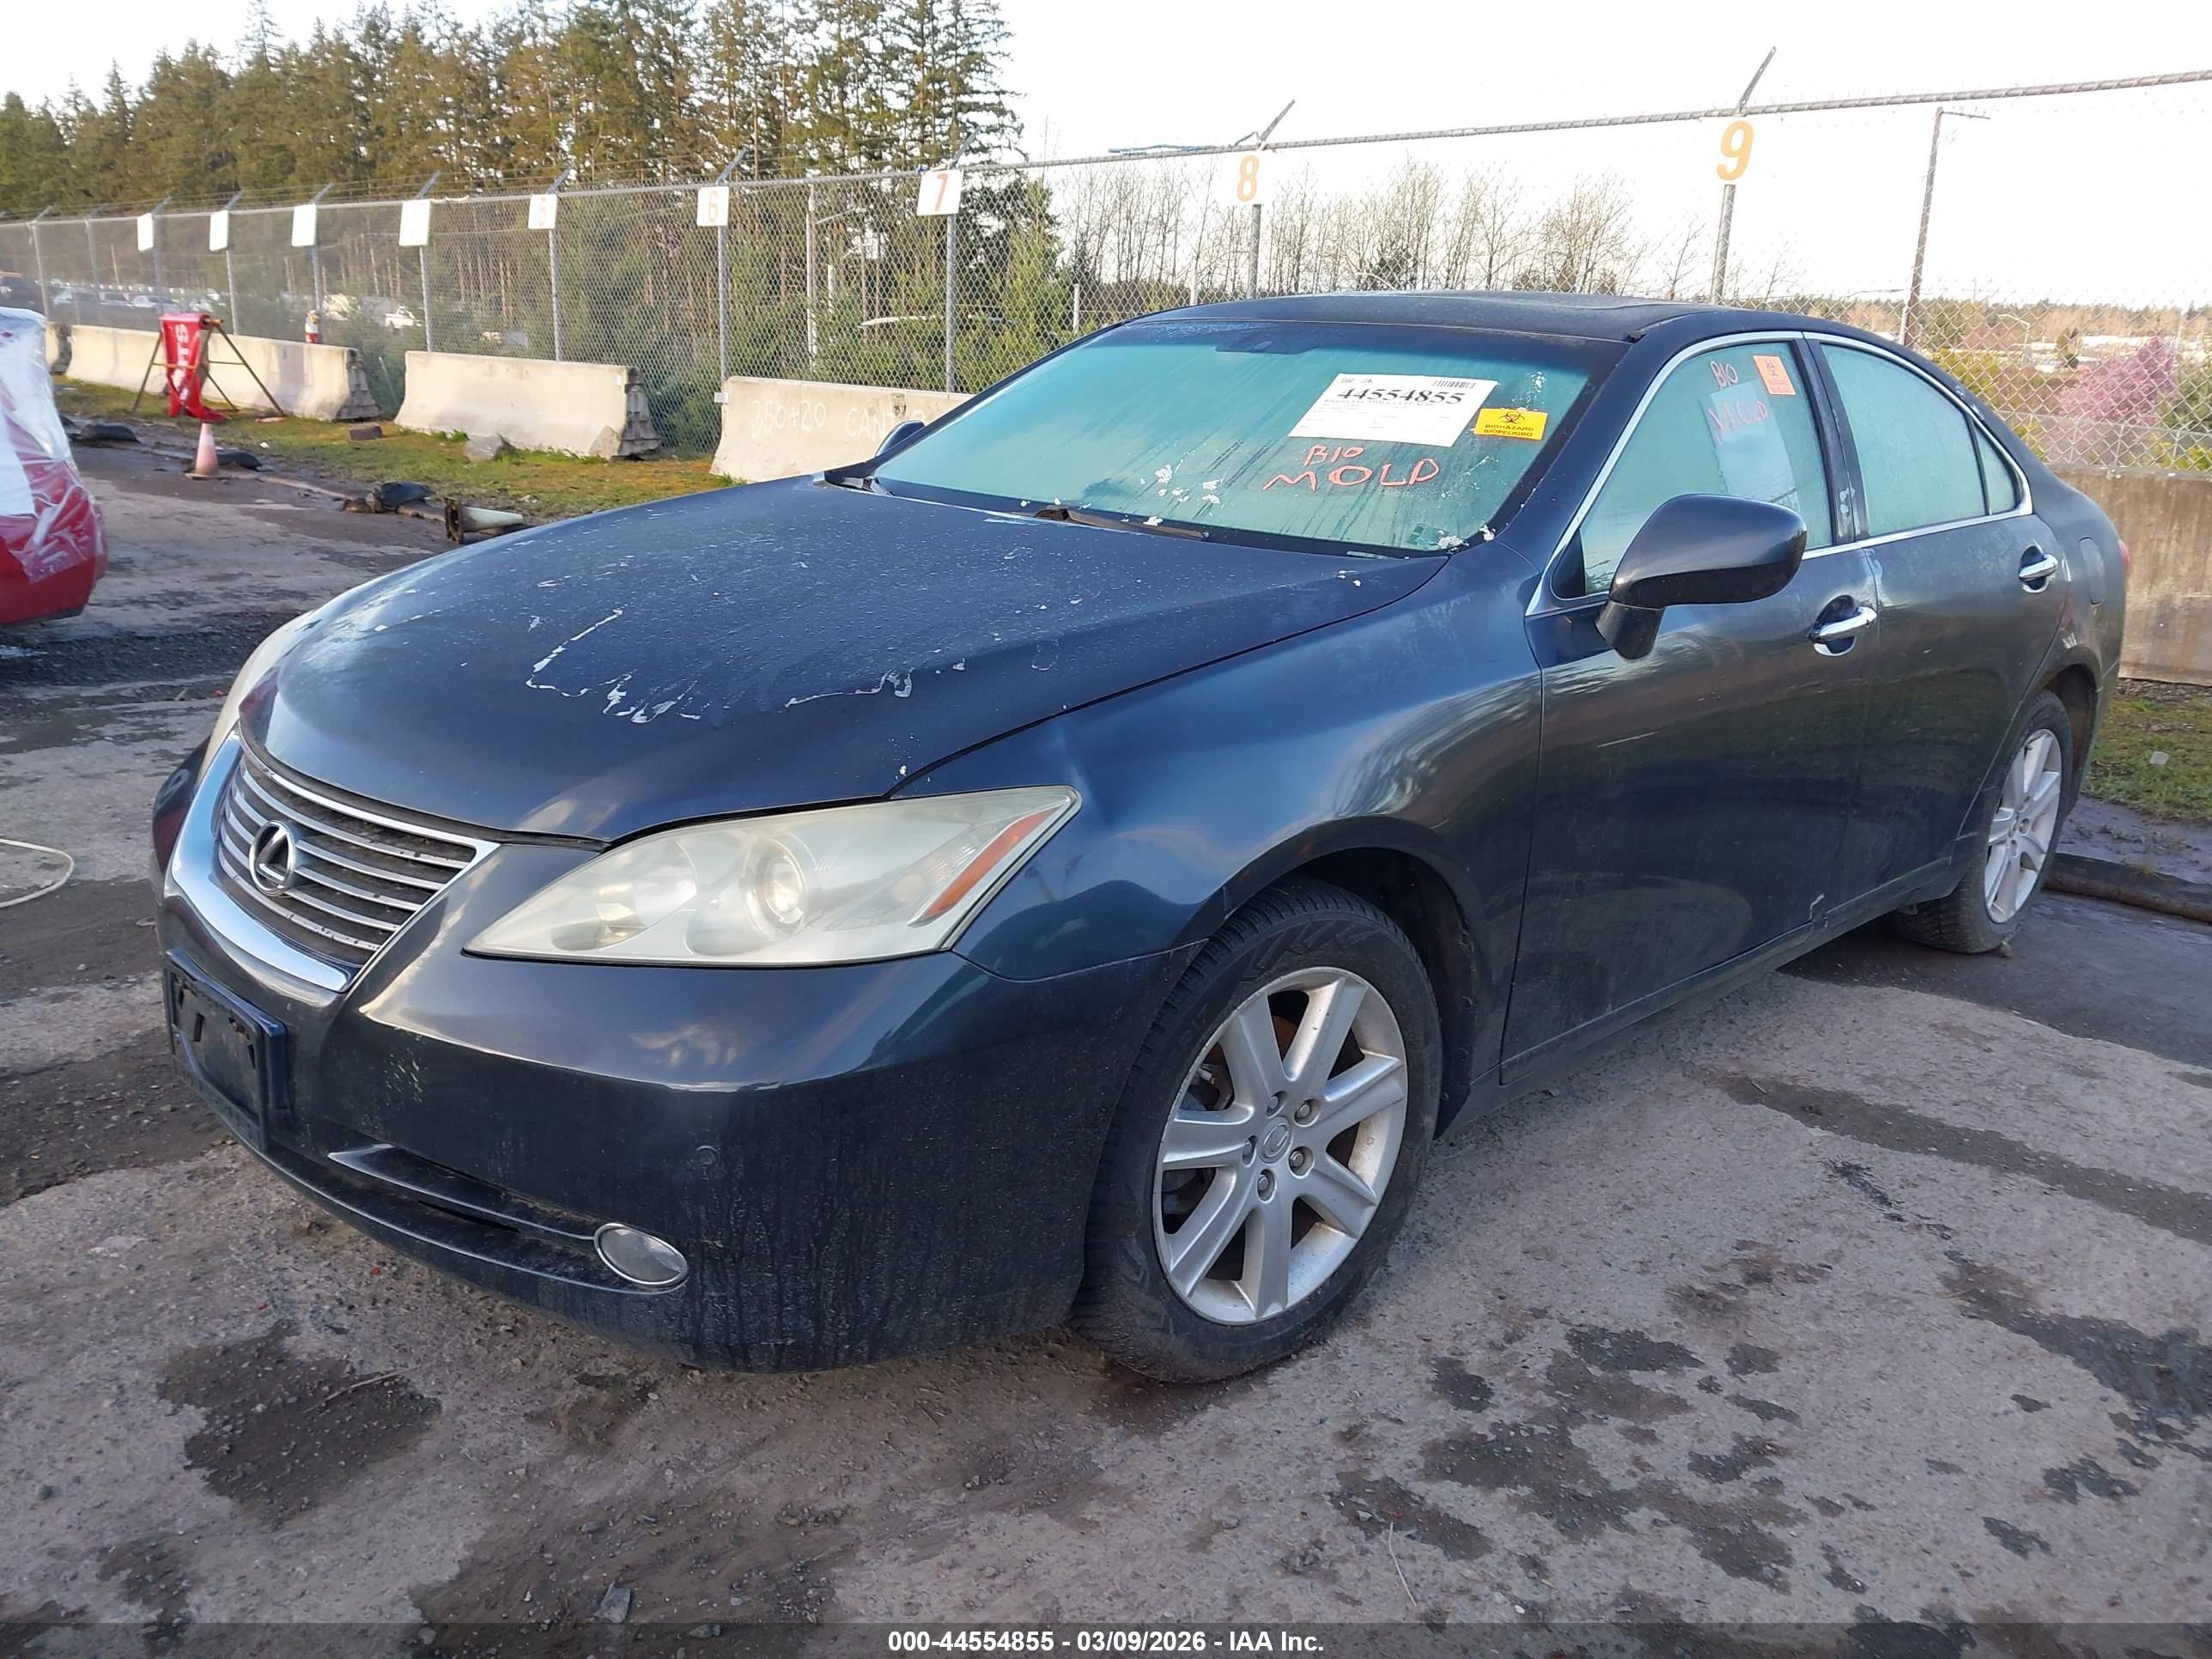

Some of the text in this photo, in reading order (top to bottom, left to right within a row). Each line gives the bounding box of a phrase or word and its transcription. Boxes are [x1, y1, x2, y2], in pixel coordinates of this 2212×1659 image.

[1717, 120, 1753, 180] 9
[935, 173, 948, 212] 7
[1237, 155, 1259, 202] 8
[708, 190, 719, 223] 6
[1337, 387, 1466, 404] 44554855
[1304, 444, 1364, 466] BIO
[1262, 458, 1440, 493] MOLD
